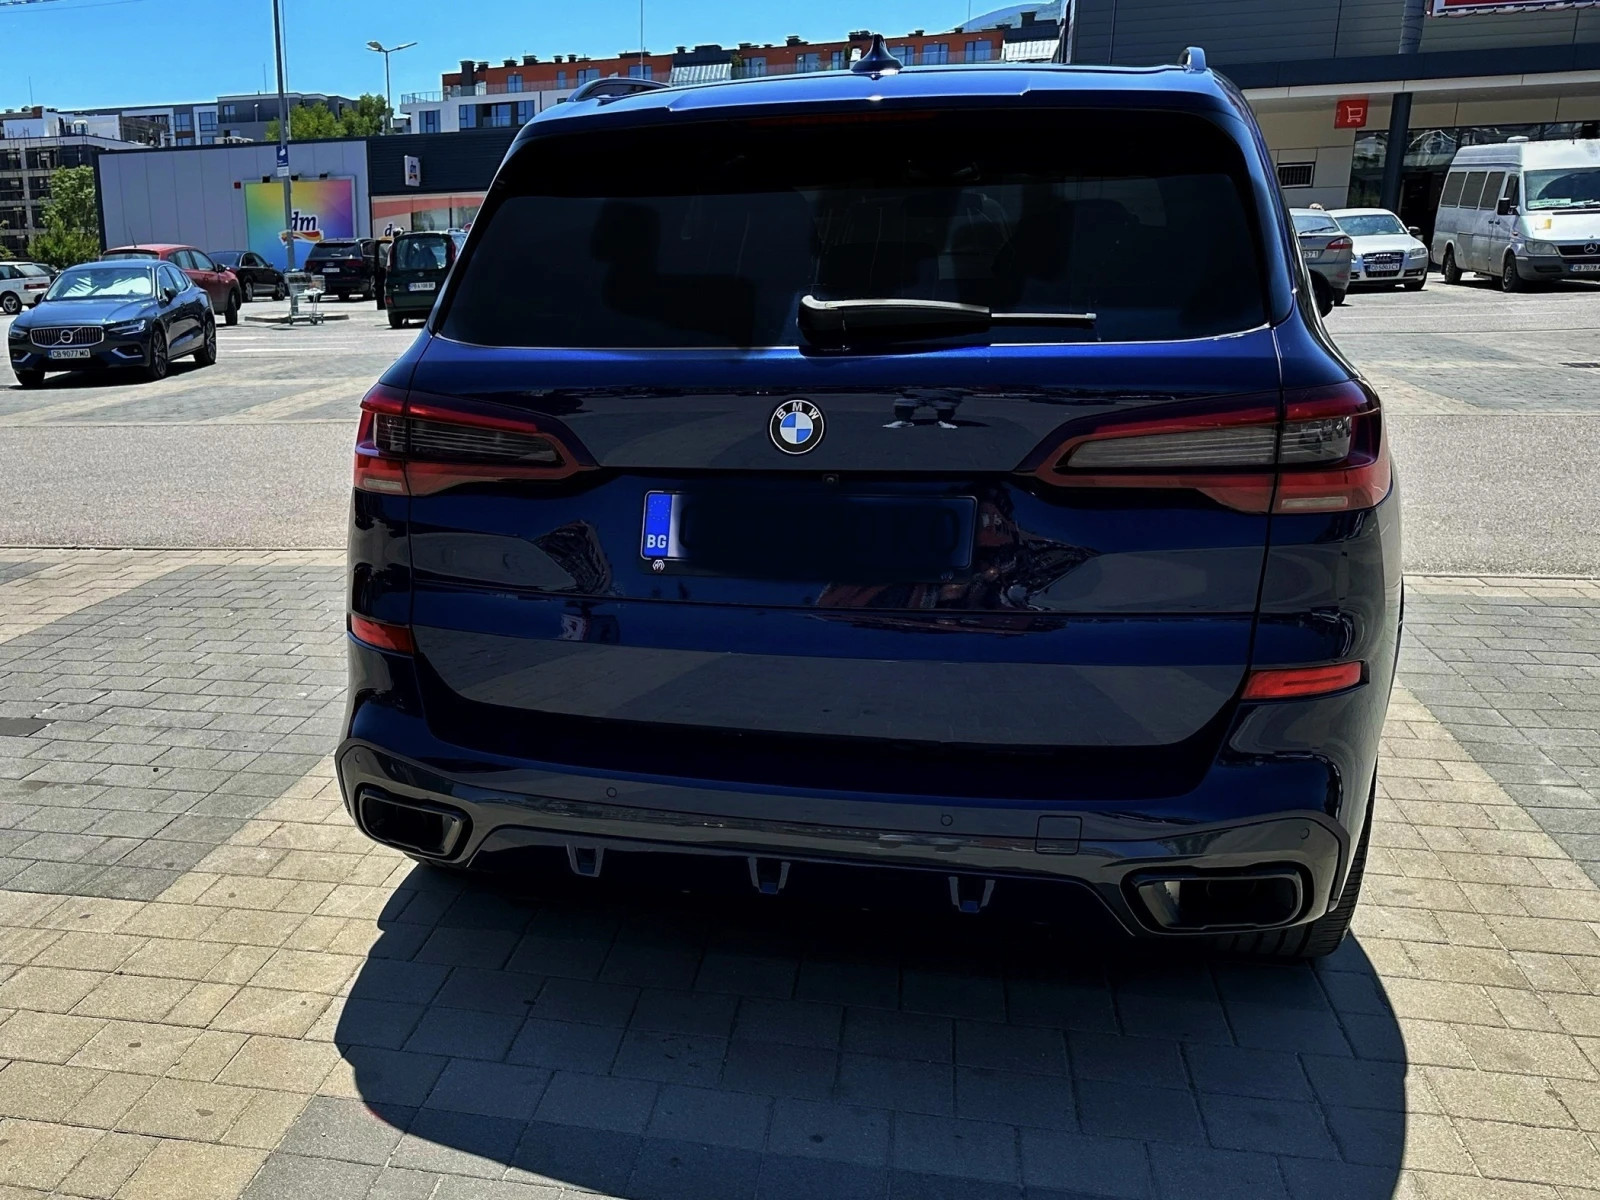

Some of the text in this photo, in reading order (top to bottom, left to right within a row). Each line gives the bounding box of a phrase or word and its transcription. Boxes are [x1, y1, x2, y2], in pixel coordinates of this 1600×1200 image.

[291, 211, 317, 231] dm
[52, 350, 61, 358] CB
[62, 350, 78, 358] 9077
[776, 402, 820, 420] BMW
[646, 534, 667, 549] BG
